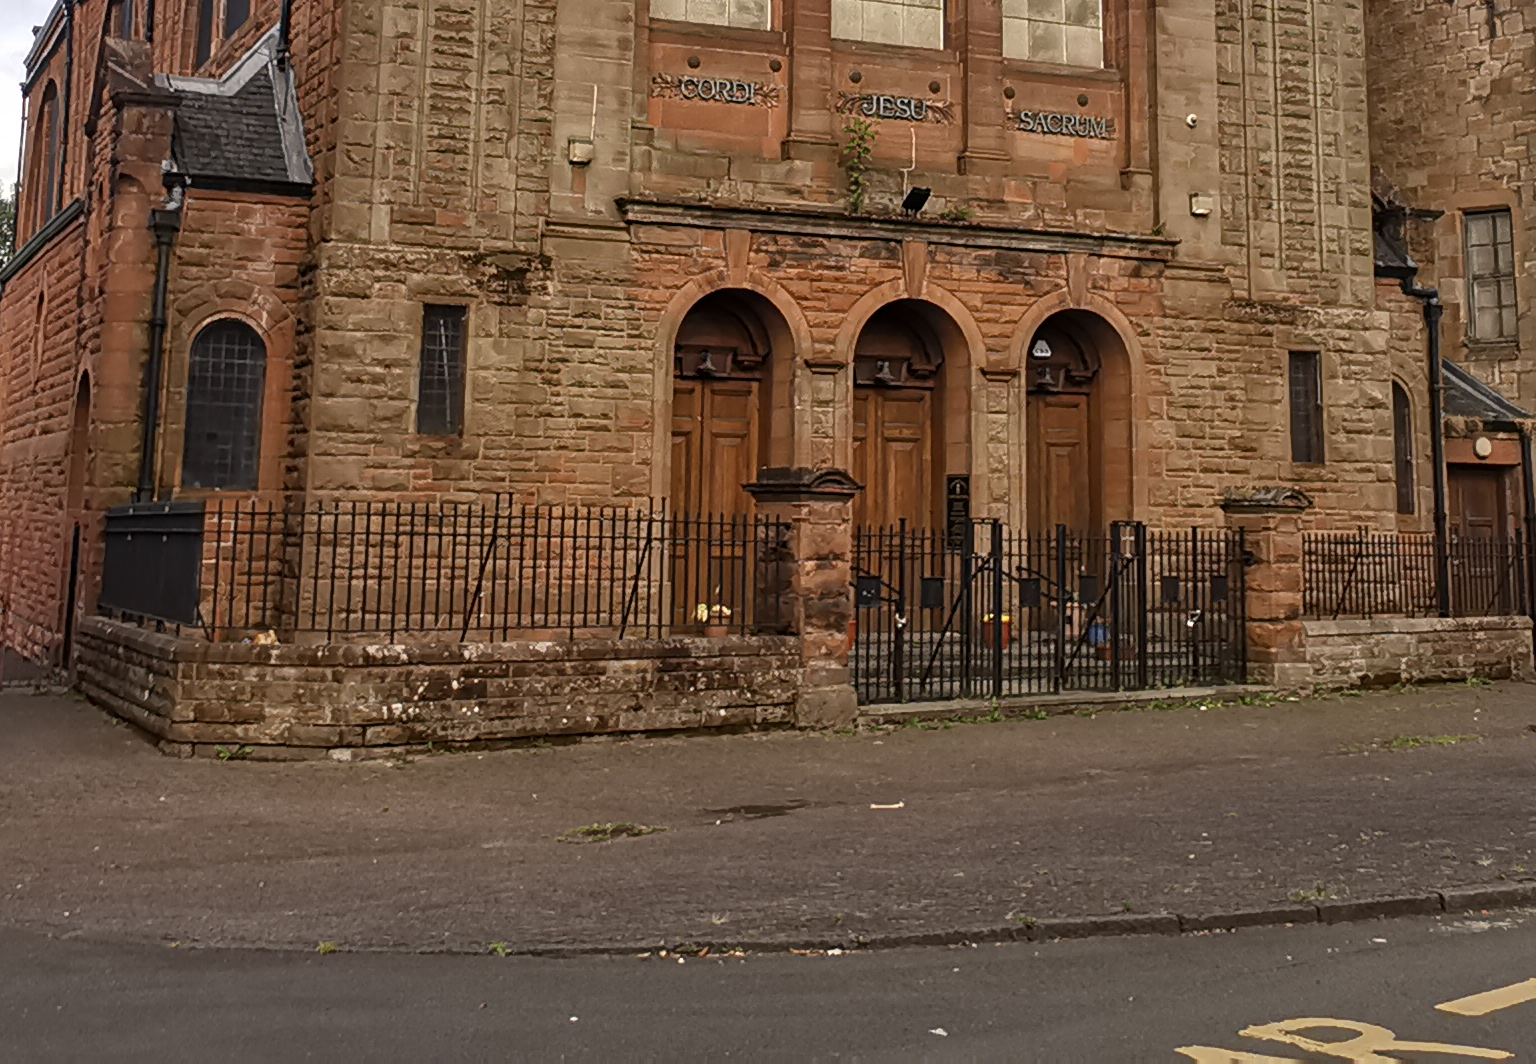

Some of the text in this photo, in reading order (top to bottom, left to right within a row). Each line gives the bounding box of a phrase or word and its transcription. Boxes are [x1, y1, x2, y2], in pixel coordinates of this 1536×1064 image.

[681, 77, 1109, 139] CORDI JESU SACRUM
